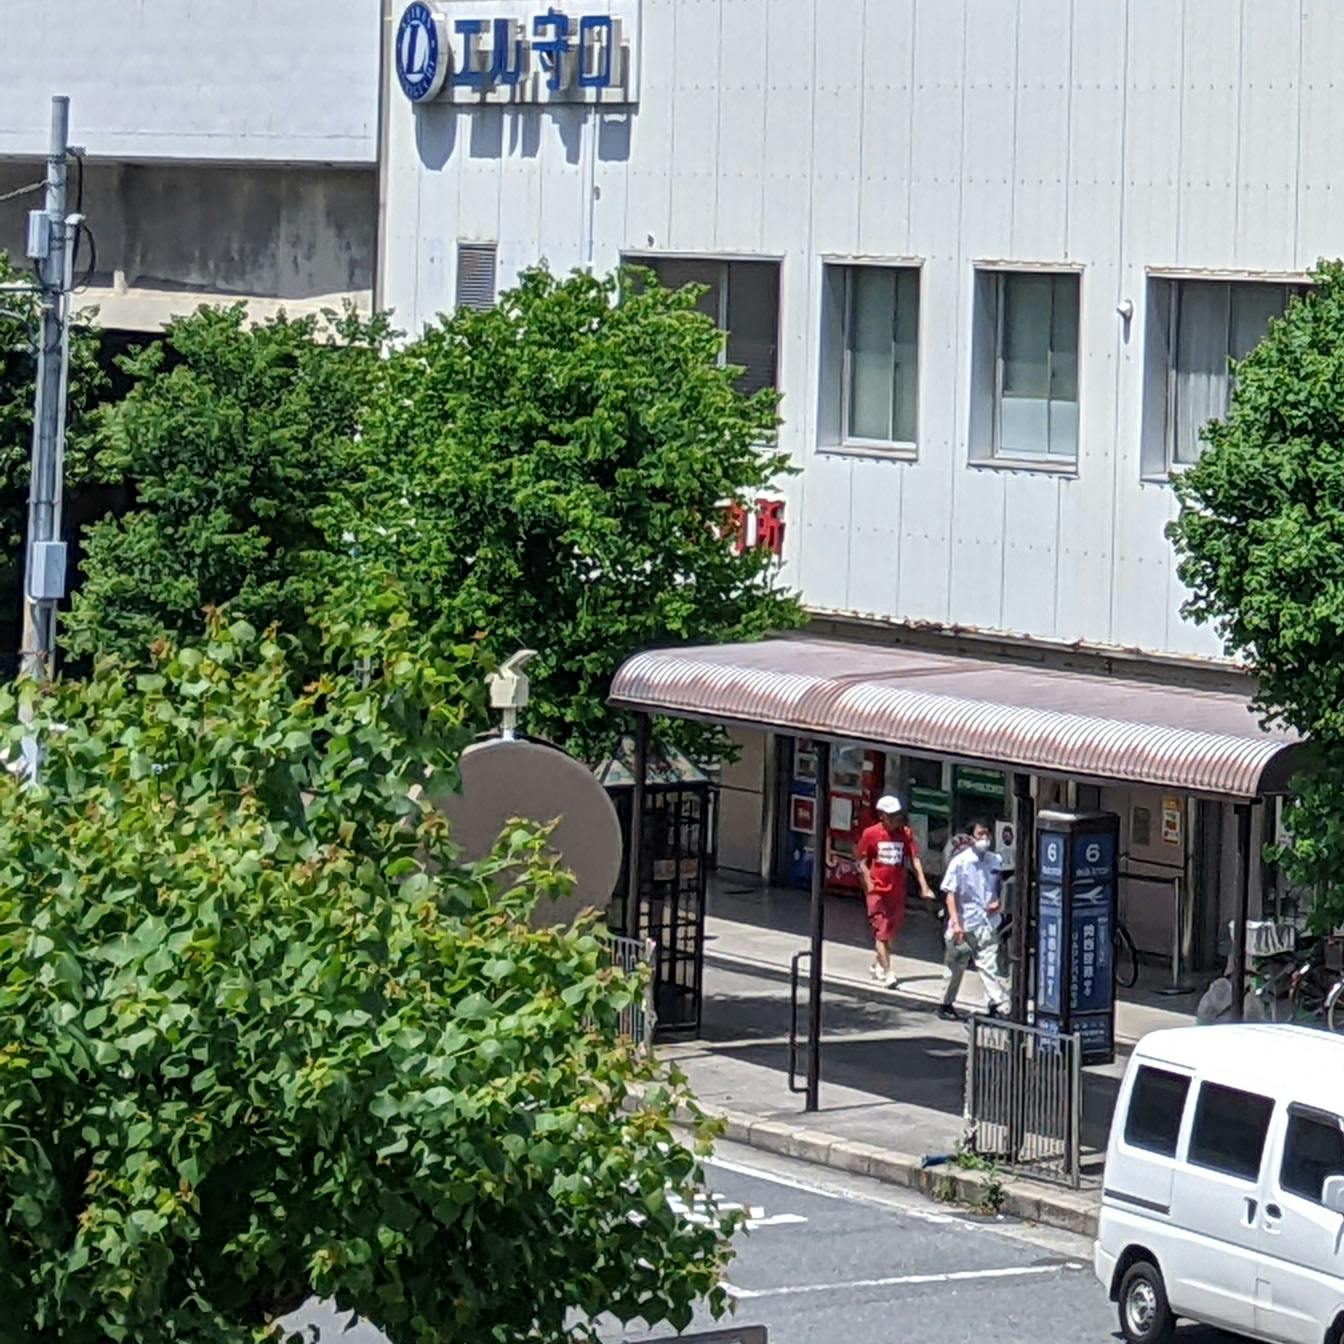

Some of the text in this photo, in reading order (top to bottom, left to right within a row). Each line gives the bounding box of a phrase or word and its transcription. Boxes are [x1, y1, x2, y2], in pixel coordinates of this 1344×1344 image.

[452, 6, 612, 91] エル守口
[1047, 842, 1057, 863] 6
[1086, 843, 1101, 863] 6
